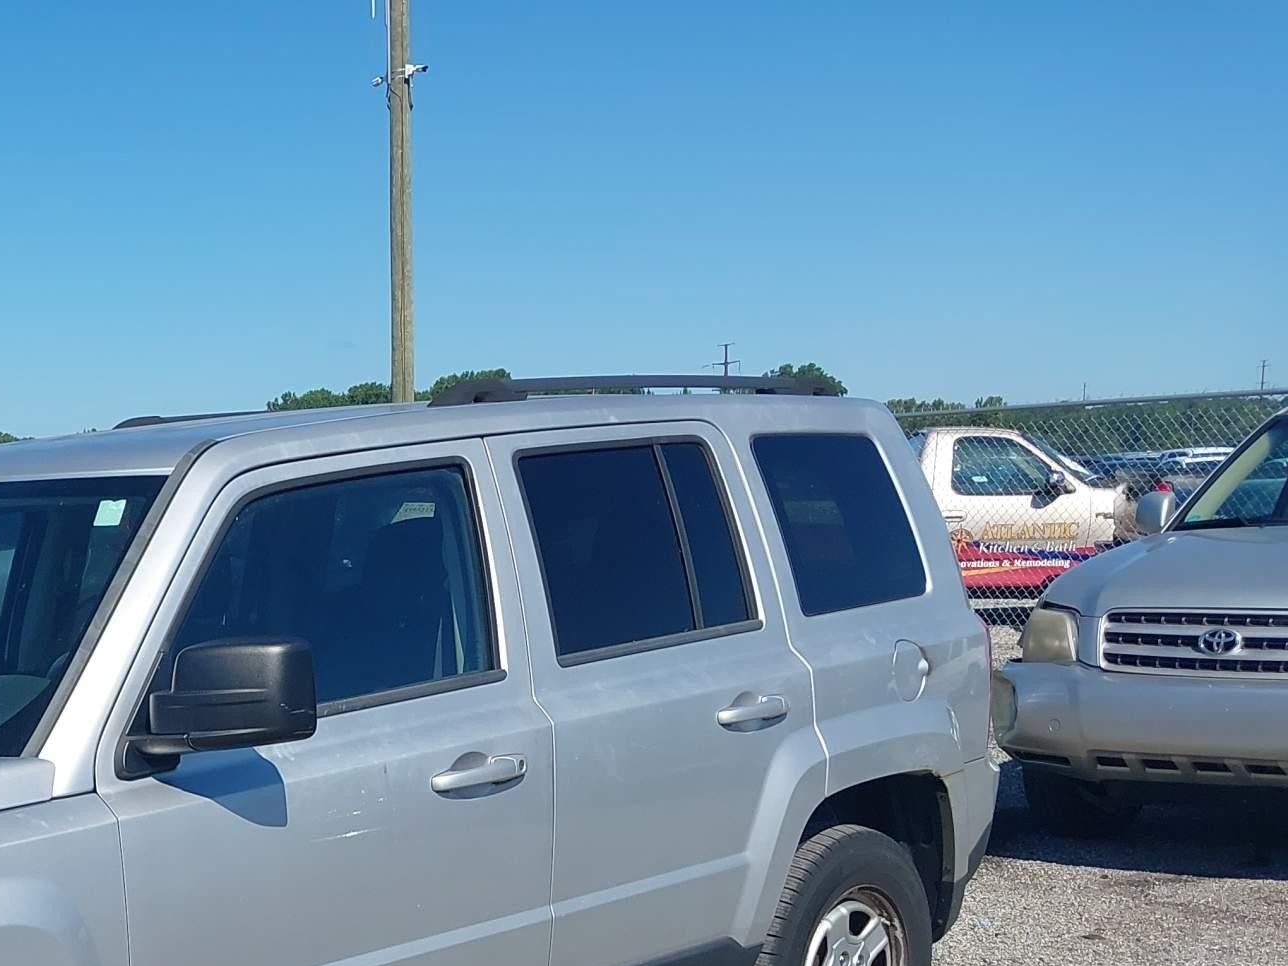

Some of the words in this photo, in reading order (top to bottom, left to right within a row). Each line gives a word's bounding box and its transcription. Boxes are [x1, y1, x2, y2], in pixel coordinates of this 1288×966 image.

[980, 520, 1080, 540] ATLANTIC
[978, 541, 1028, 553] Kitchen
[1046, 540, 1077, 552] Bath
[958, 559, 999, 568] ovations
[1001, 559, 1011, 568] &
[1013, 558, 1071, 568] Remodeling
